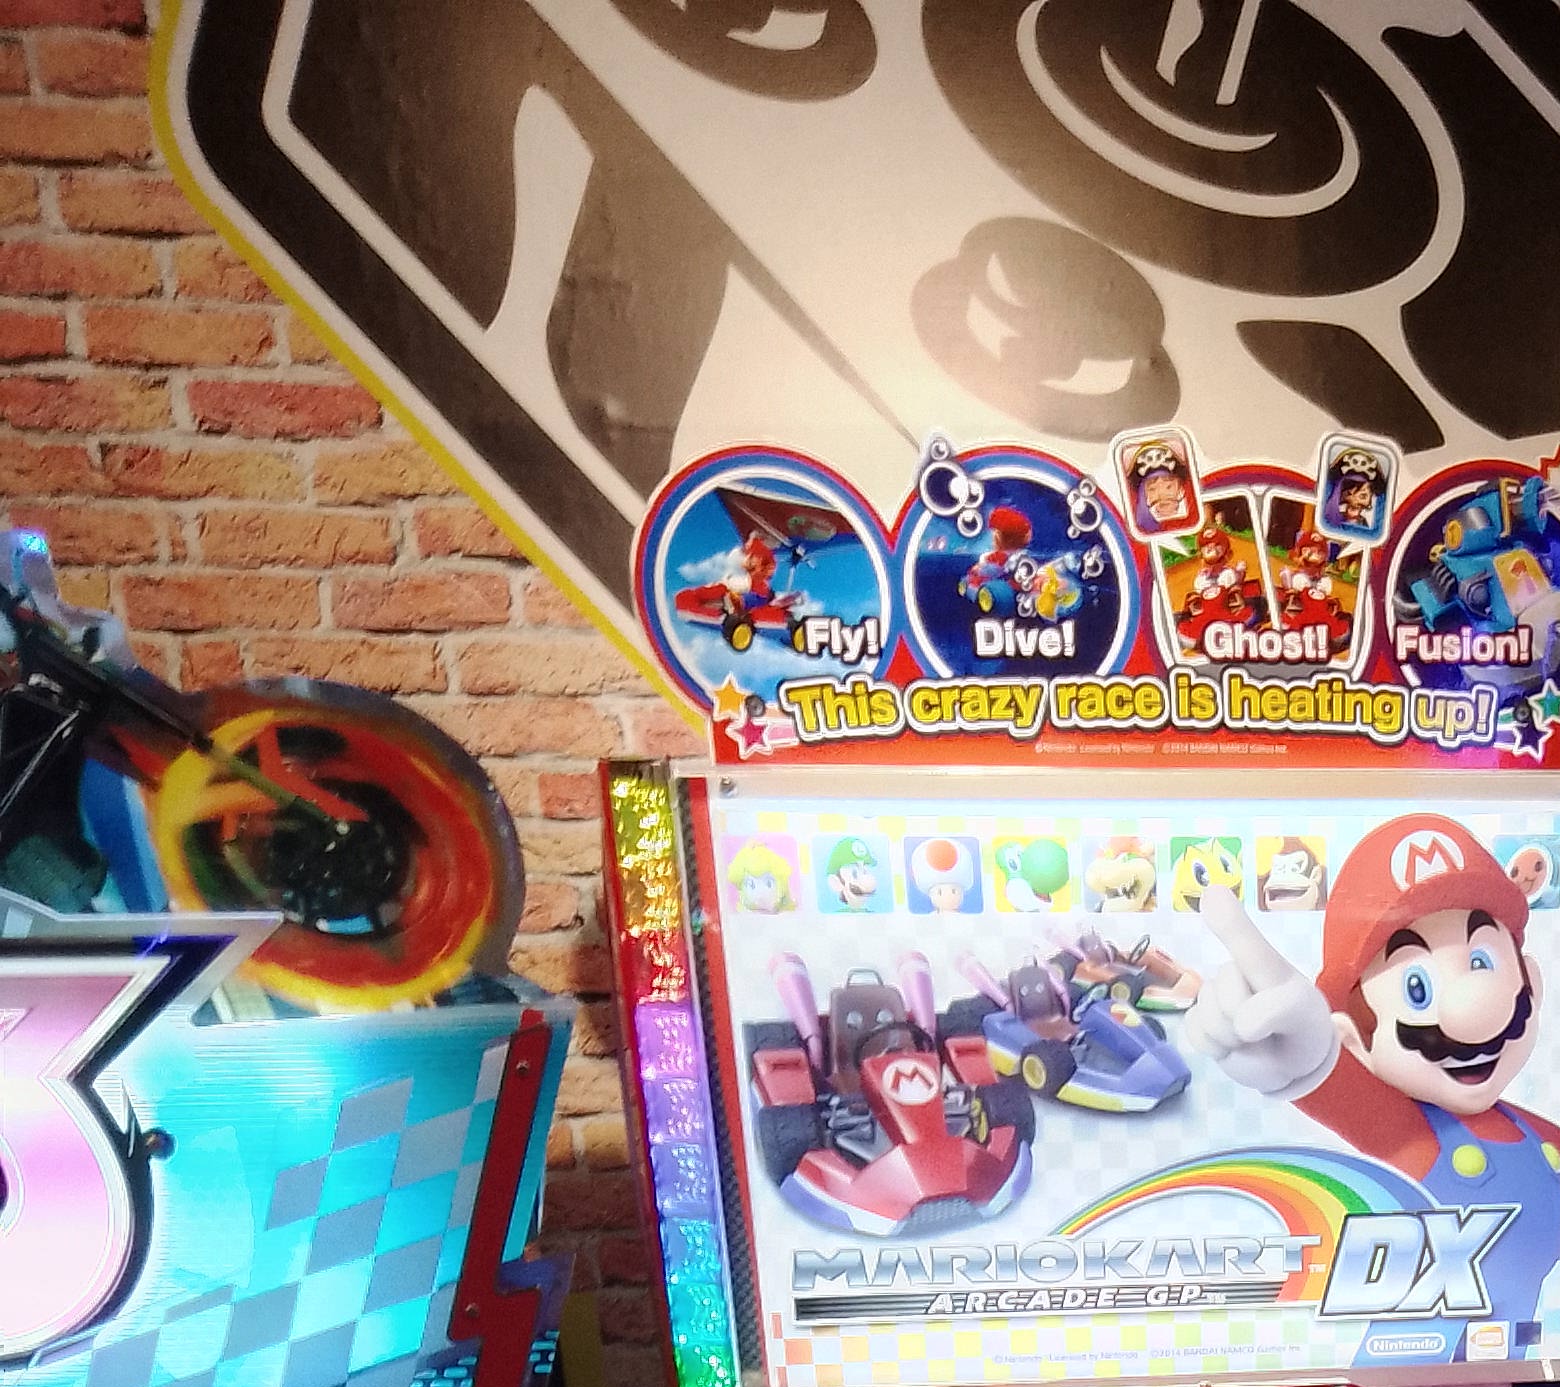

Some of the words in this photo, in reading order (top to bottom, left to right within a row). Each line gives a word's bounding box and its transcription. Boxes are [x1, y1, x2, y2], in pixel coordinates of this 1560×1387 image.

[805, 620, 881, 661] Fly!
[974, 622, 1076, 659] Dive!
[1204, 623, 1329, 662] Ghost!
[1396, 625, 1530, 664] Fusion!
[787, 681, 897, 732] This
[911, 686, 1042, 728] crazy
[1057, 682, 1162, 720] race
[1176, 676, 1216, 719] is
[1229, 675, 1403, 733] heating
[1417, 695, 1489, 738] up!
[1320, 1204, 1520, 1318] DX
[930, 1286, 1119, 1315] ARCADE
[1145, 1283, 1204, 1307] GP
[1371, 1337, 1441, 1353] Nintendo
